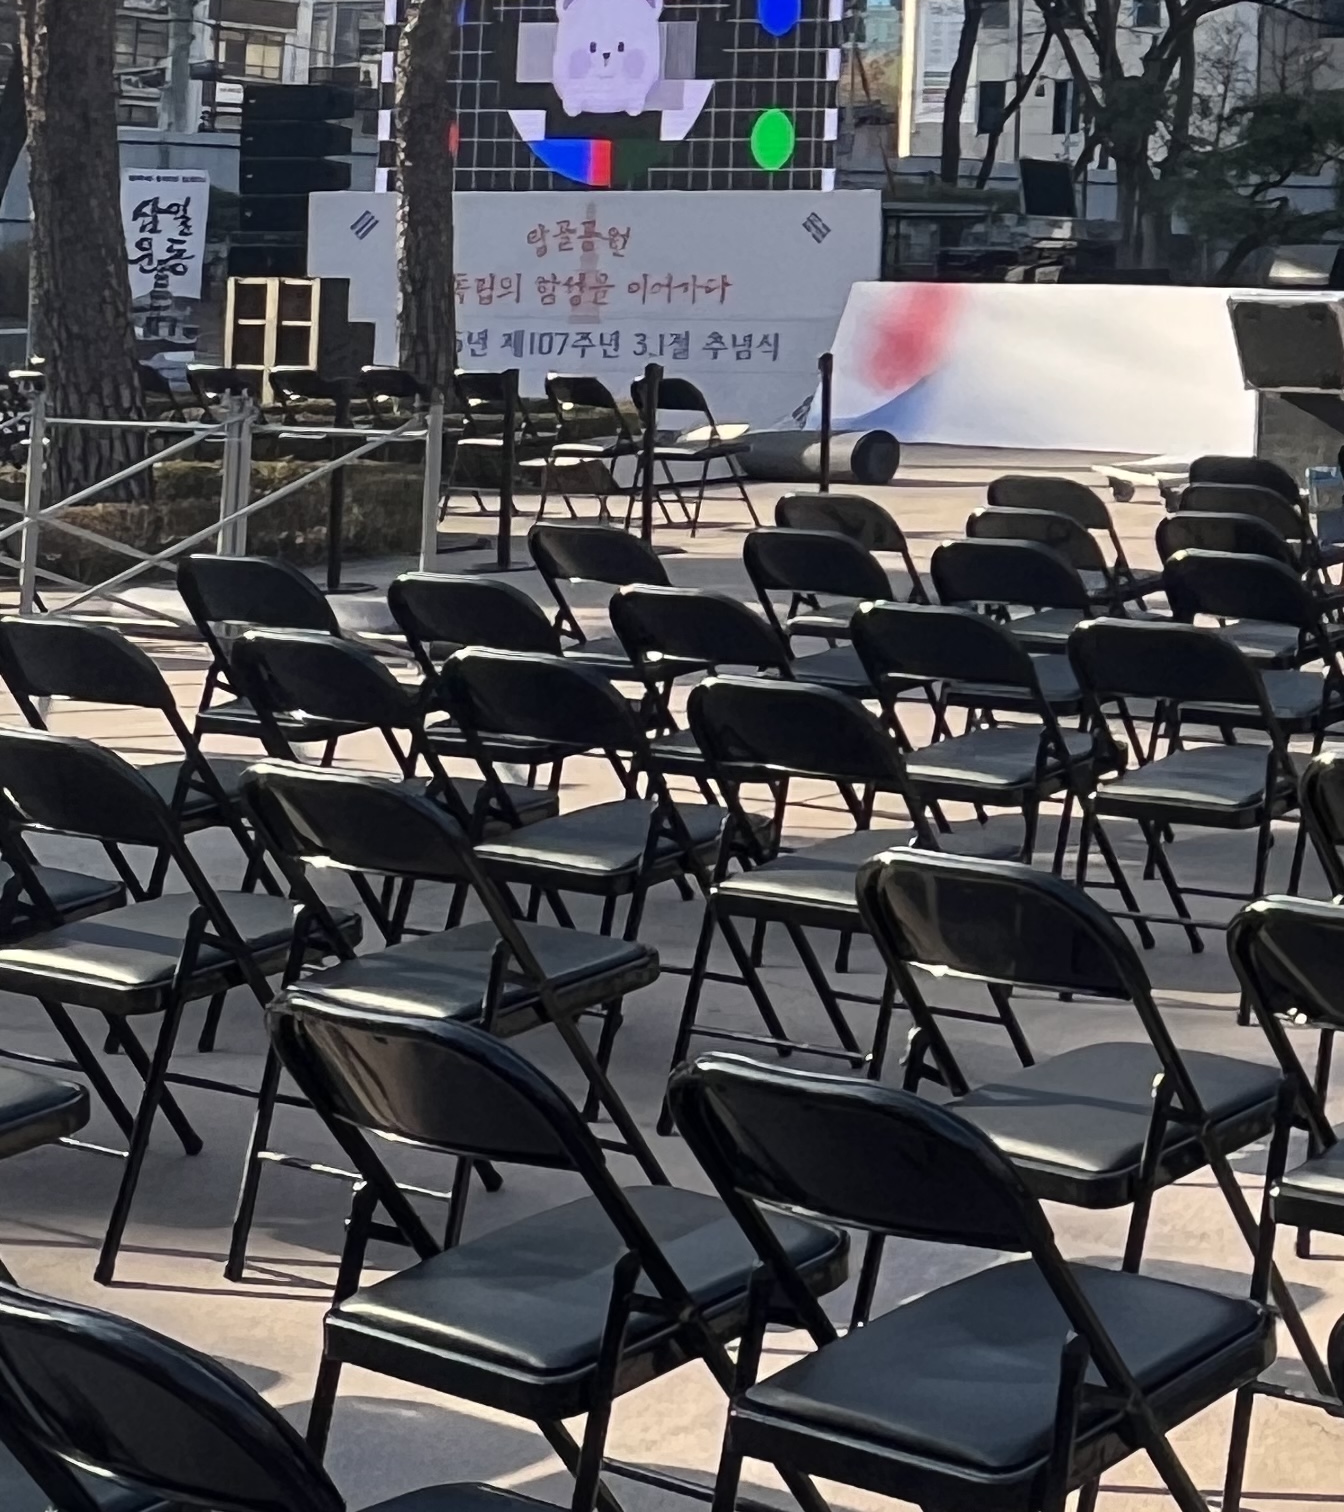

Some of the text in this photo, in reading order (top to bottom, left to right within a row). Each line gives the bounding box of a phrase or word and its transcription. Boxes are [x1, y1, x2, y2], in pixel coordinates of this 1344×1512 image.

[626, 272, 734, 305] 이어가다
[500, 329, 621, 359] 제107주년
[701, 330, 781, 362] 추념식
